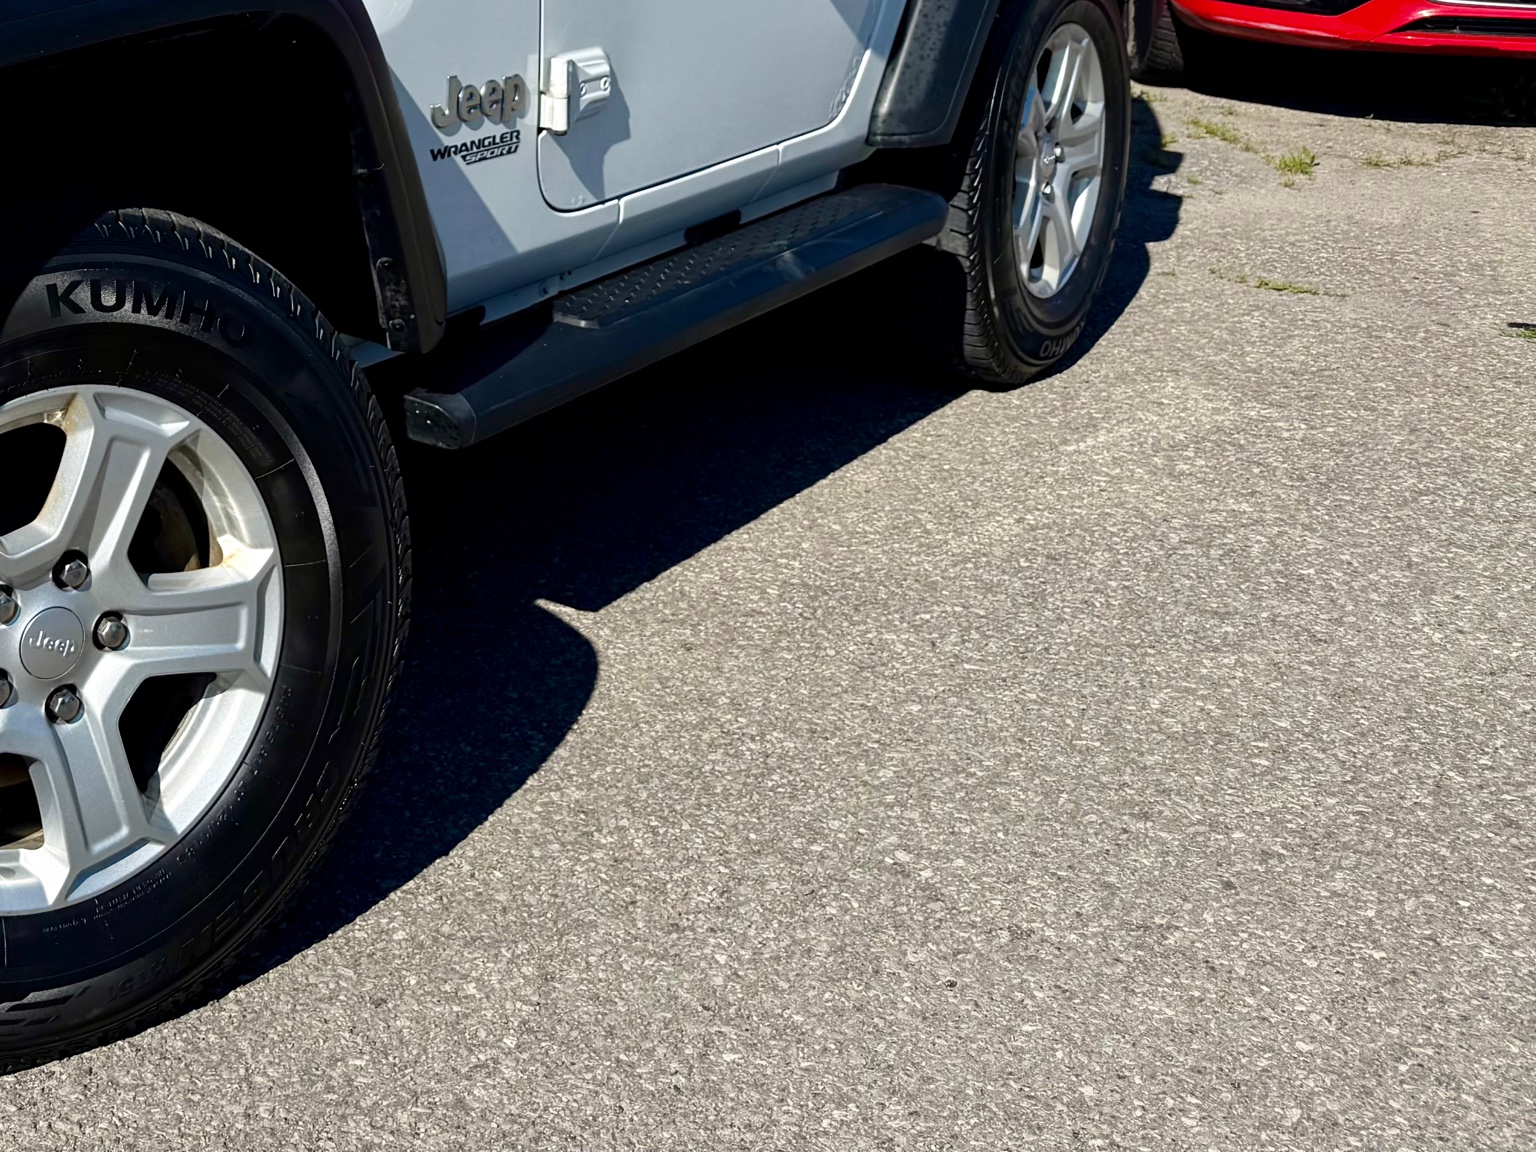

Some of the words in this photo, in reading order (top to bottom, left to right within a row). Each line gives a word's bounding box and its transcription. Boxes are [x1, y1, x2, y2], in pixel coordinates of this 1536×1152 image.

[430, 74, 526, 128] Jeep
[430, 129, 520, 162] WRANGLER
[465, 144, 517, 163] SPORT
[45, 278, 247, 346] KUMHO
[29, 630, 75, 657] Jeep
